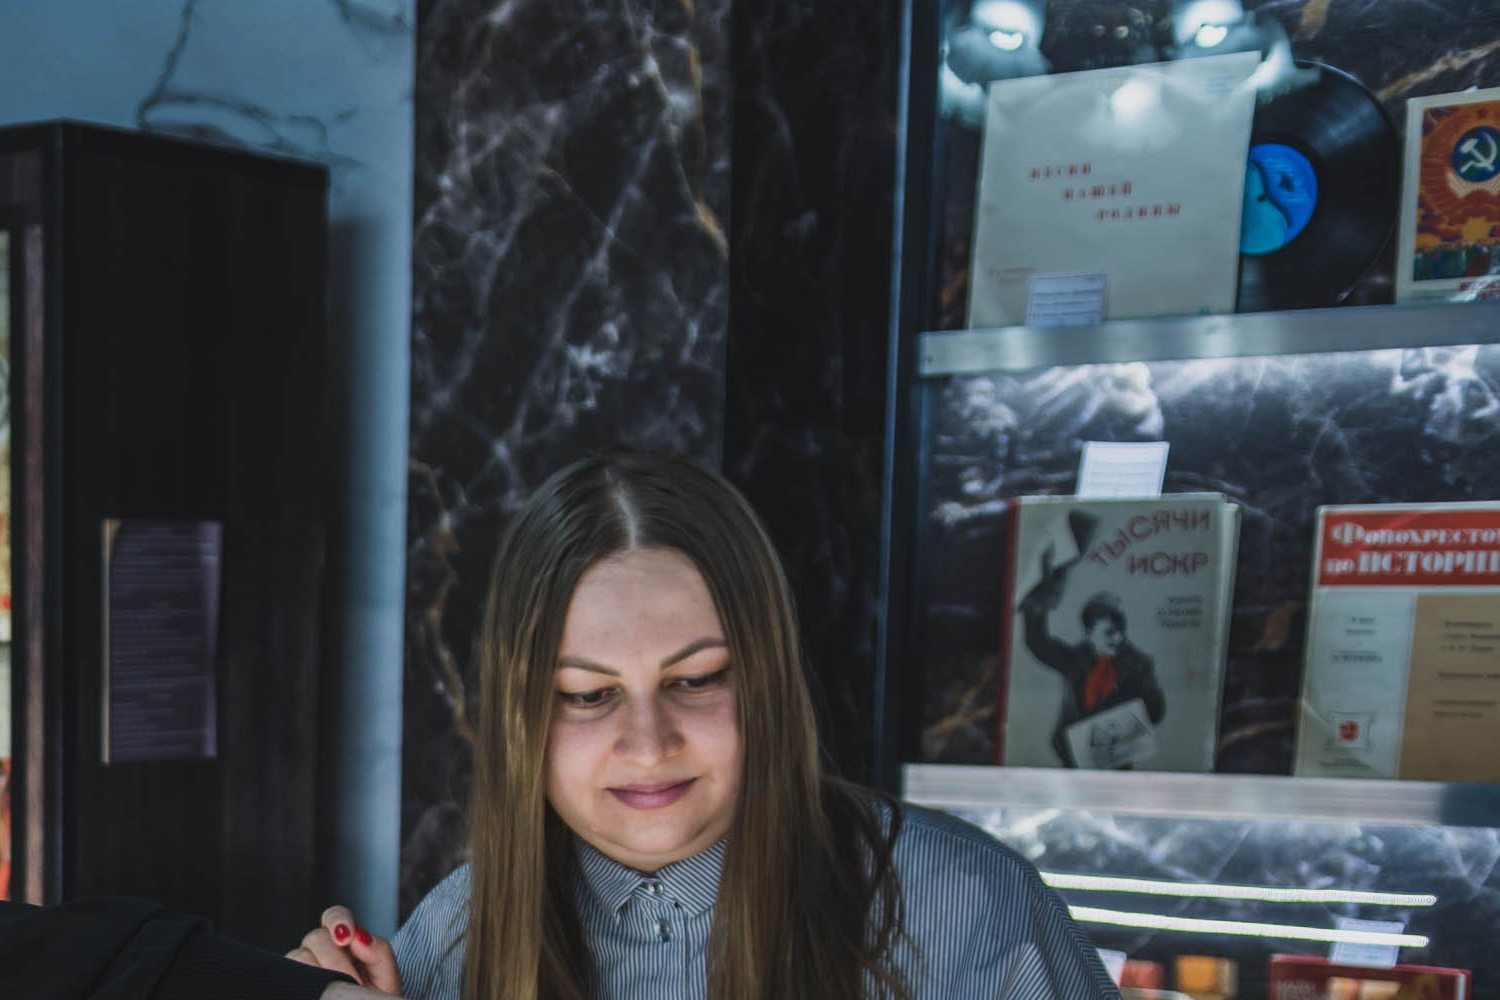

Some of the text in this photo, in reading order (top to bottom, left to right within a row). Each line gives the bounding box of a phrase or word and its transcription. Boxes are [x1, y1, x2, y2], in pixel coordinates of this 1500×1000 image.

[1088, 508, 1211, 567] ТЫСЯЧИ
[1331, 522, 1500, 545] ФОНОХРЕСТО
[1128, 551, 1209, 576] ИСКР
